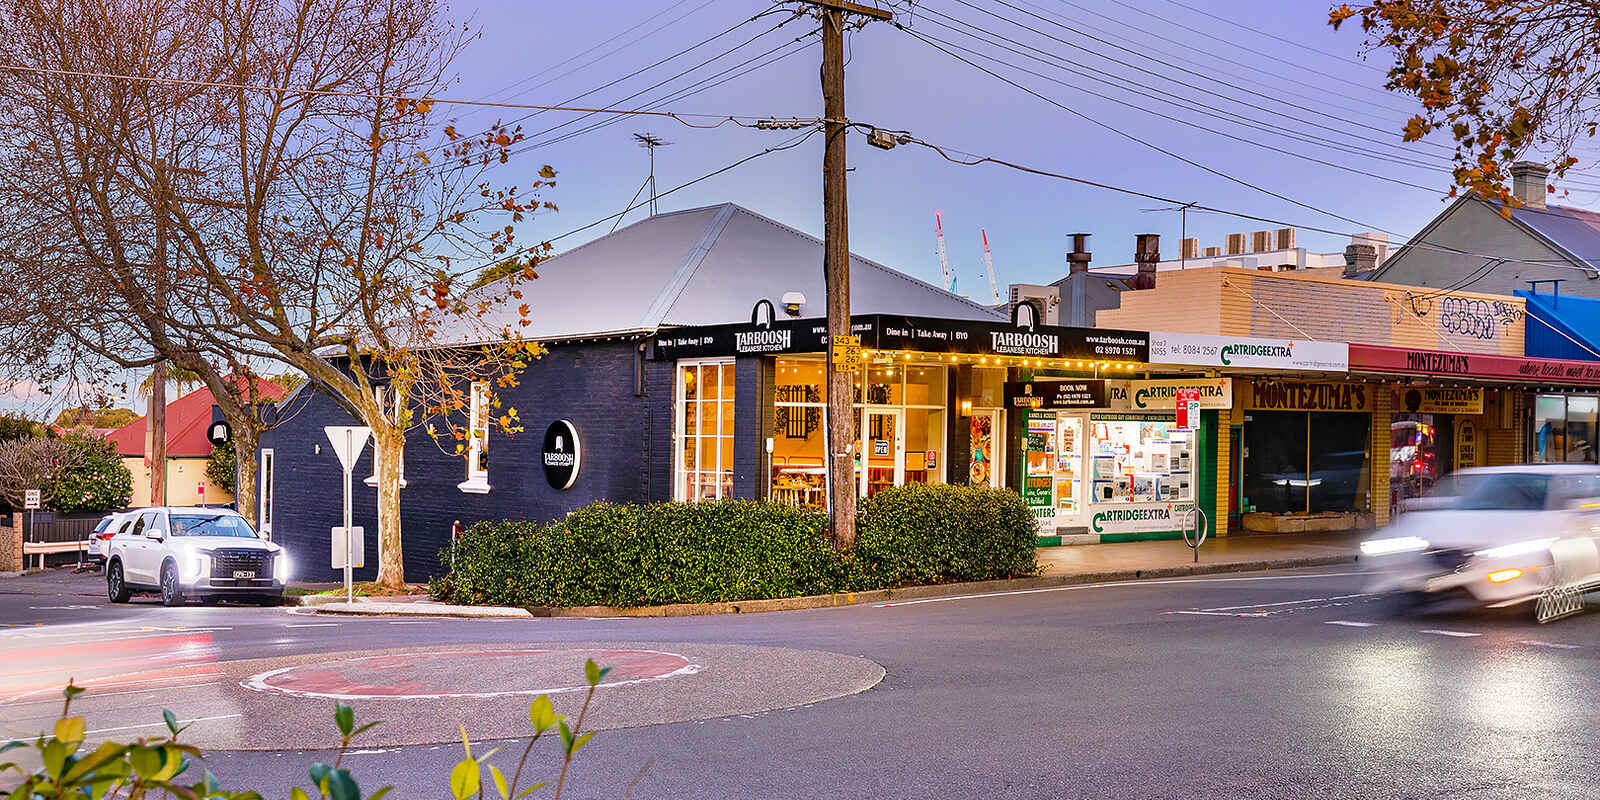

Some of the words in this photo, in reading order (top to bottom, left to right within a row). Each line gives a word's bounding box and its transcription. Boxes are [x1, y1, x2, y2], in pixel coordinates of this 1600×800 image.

[734, 329, 792, 351] TARBOOSH
[834, 337, 850, 345] 343
[886, 327, 900, 337] Dine
[917, 329, 931, 338] Take
[932, 330, 947, 341] Away
[955, 331, 968, 340] BYO
[1086, 336, 1146, 346] www.tarboosh.com.au
[989, 331, 1059, 355] TARBOOSH
[1183, 344, 1201, 355] 8084
[1202, 346, 1218, 356] 2567
[996, 346, 1024, 354] LEBANESE
[1025, 347, 1049, 355] KITCHEN
[1095, 346, 1103, 354] 02
[1104, 346, 1121, 355] 8970
[1121, 347, 1136, 356] 1521
[1221, 343, 1293, 366] CARTRIDGEEXTRA
[1407, 351, 1469, 374] MONTEZUMA'S
[1541, 362, 1565, 377] locals
[1566, 365, 1585, 378] meet
[1252, 381, 1366, 410] MONTEZUMA'S
[1424, 389, 1479, 401] MONTEZUMA'S
[1188, 402, 1199, 410] 2P
[544, 452, 574, 466] TARBOOSH
[1093, 509, 1171, 533] CARTRIDGEEXTRA
